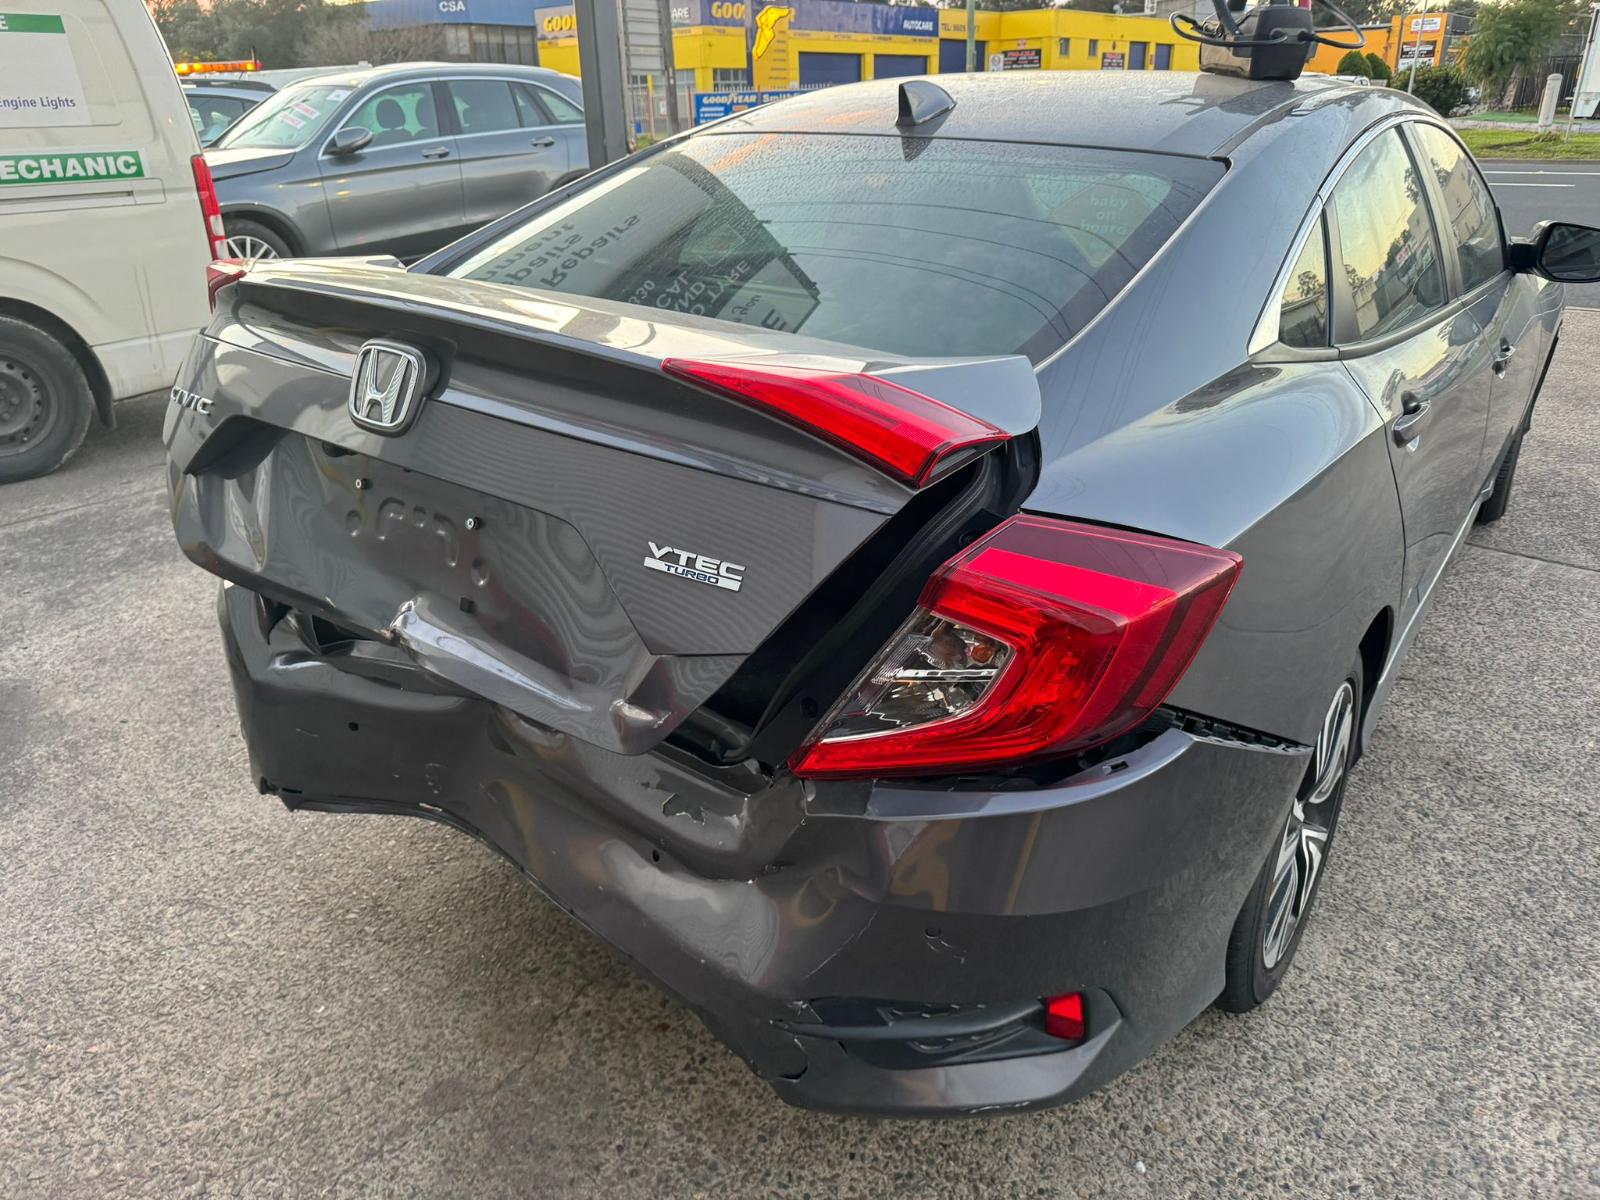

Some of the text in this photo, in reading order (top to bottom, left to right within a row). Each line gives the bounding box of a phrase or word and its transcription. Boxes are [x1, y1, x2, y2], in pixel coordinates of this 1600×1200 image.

[439, 1, 466, 12] CSA
[903, 20, 933, 31] AUTOCARE
[39, 96, 76, 110] Lights
[702, 94, 757, 104] GOODYEAR
[0, 155, 138, 180] ECHANIC
[1090, 193, 1128, 210] baby
[171, 385, 214, 414] CIVIC
[647, 541, 746, 581] VTEC
[664, 563, 720, 585] TURBO
